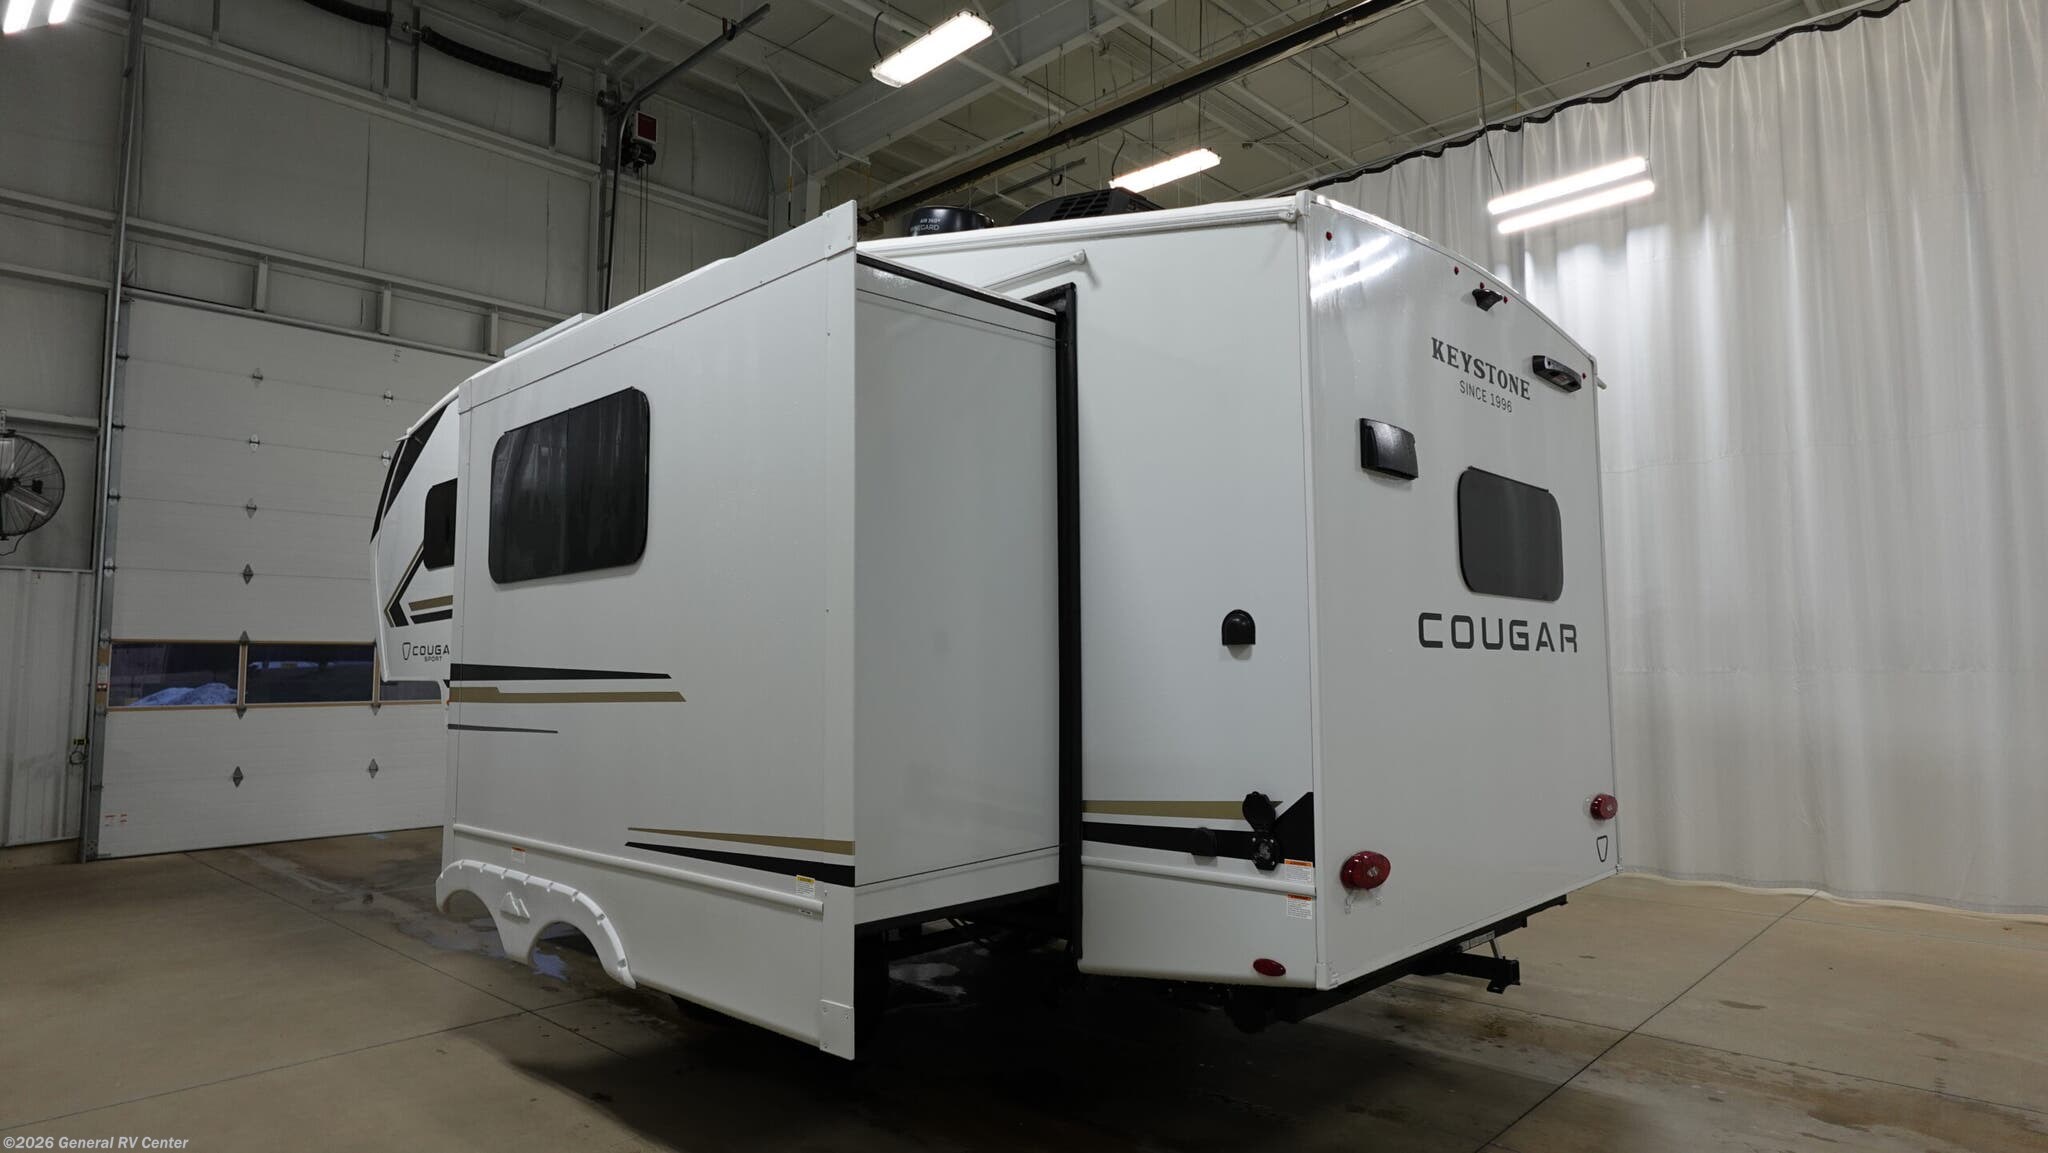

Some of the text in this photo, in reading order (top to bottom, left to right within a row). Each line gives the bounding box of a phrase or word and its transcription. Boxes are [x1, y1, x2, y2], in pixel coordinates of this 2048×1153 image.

[1431, 336, 1531, 401] KEYSTONE
[1459, 380, 1513, 413] SINCE 1996
[1418, 612, 1578, 653] COUGAR
